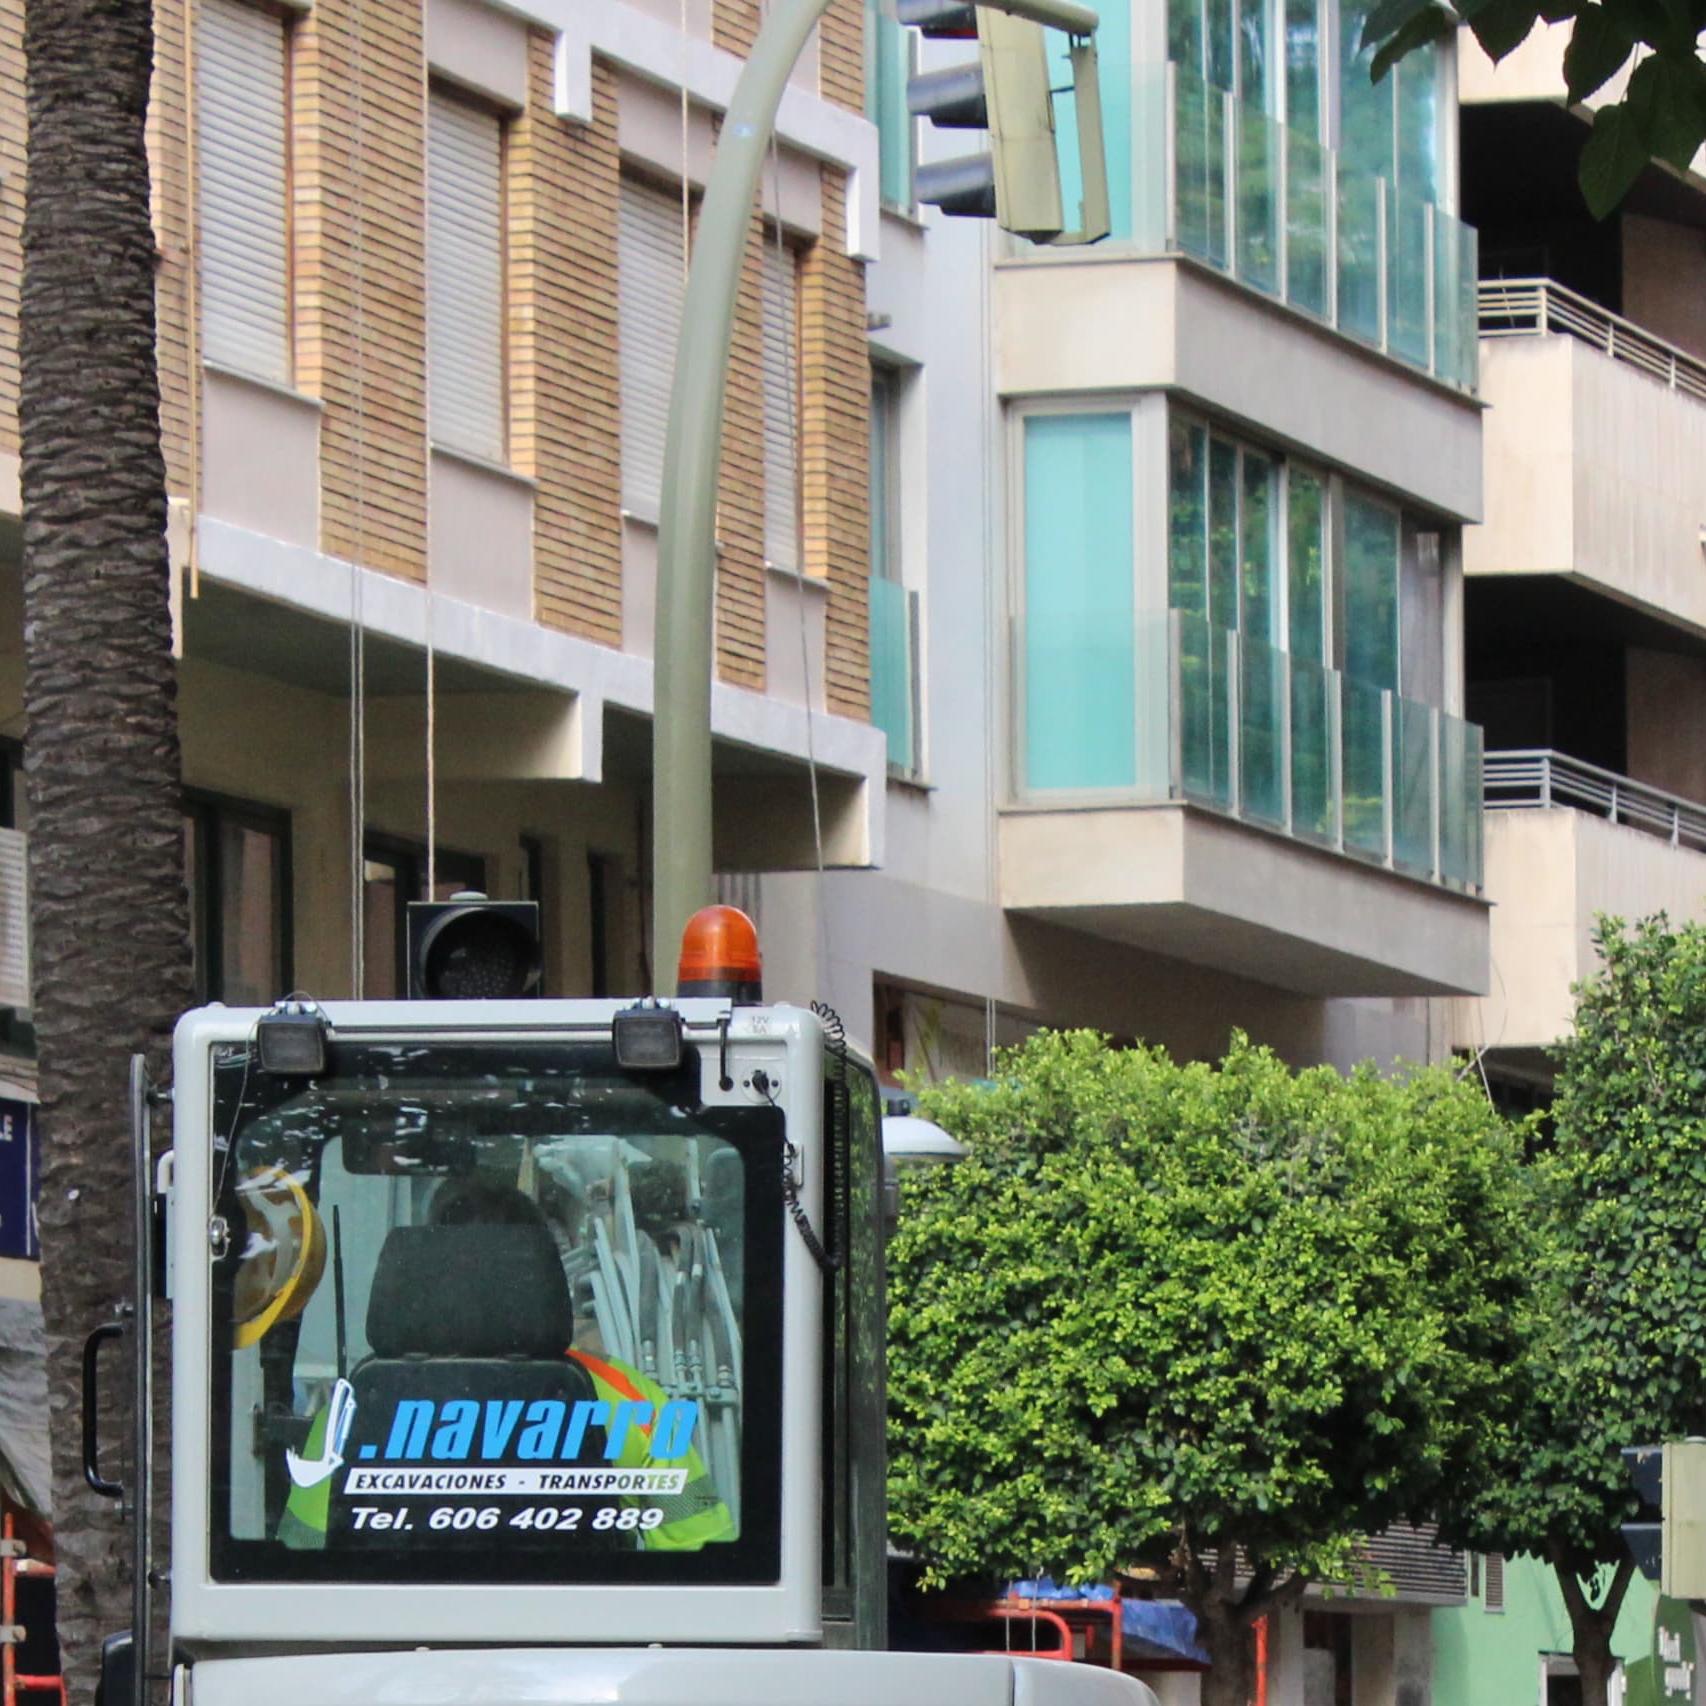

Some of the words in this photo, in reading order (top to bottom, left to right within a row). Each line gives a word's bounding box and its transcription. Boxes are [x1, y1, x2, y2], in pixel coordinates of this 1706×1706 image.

[354, 1473, 507, 1490] EXCAVACIONES
[539, 1473, 680, 1490] TRANSPORTES
[350, 1507, 414, 1530] Tel.
[428, 1507, 501, 1531] 606
[508, 1507, 585, 1531] 402
[591, 1507, 665, 1531] 889
